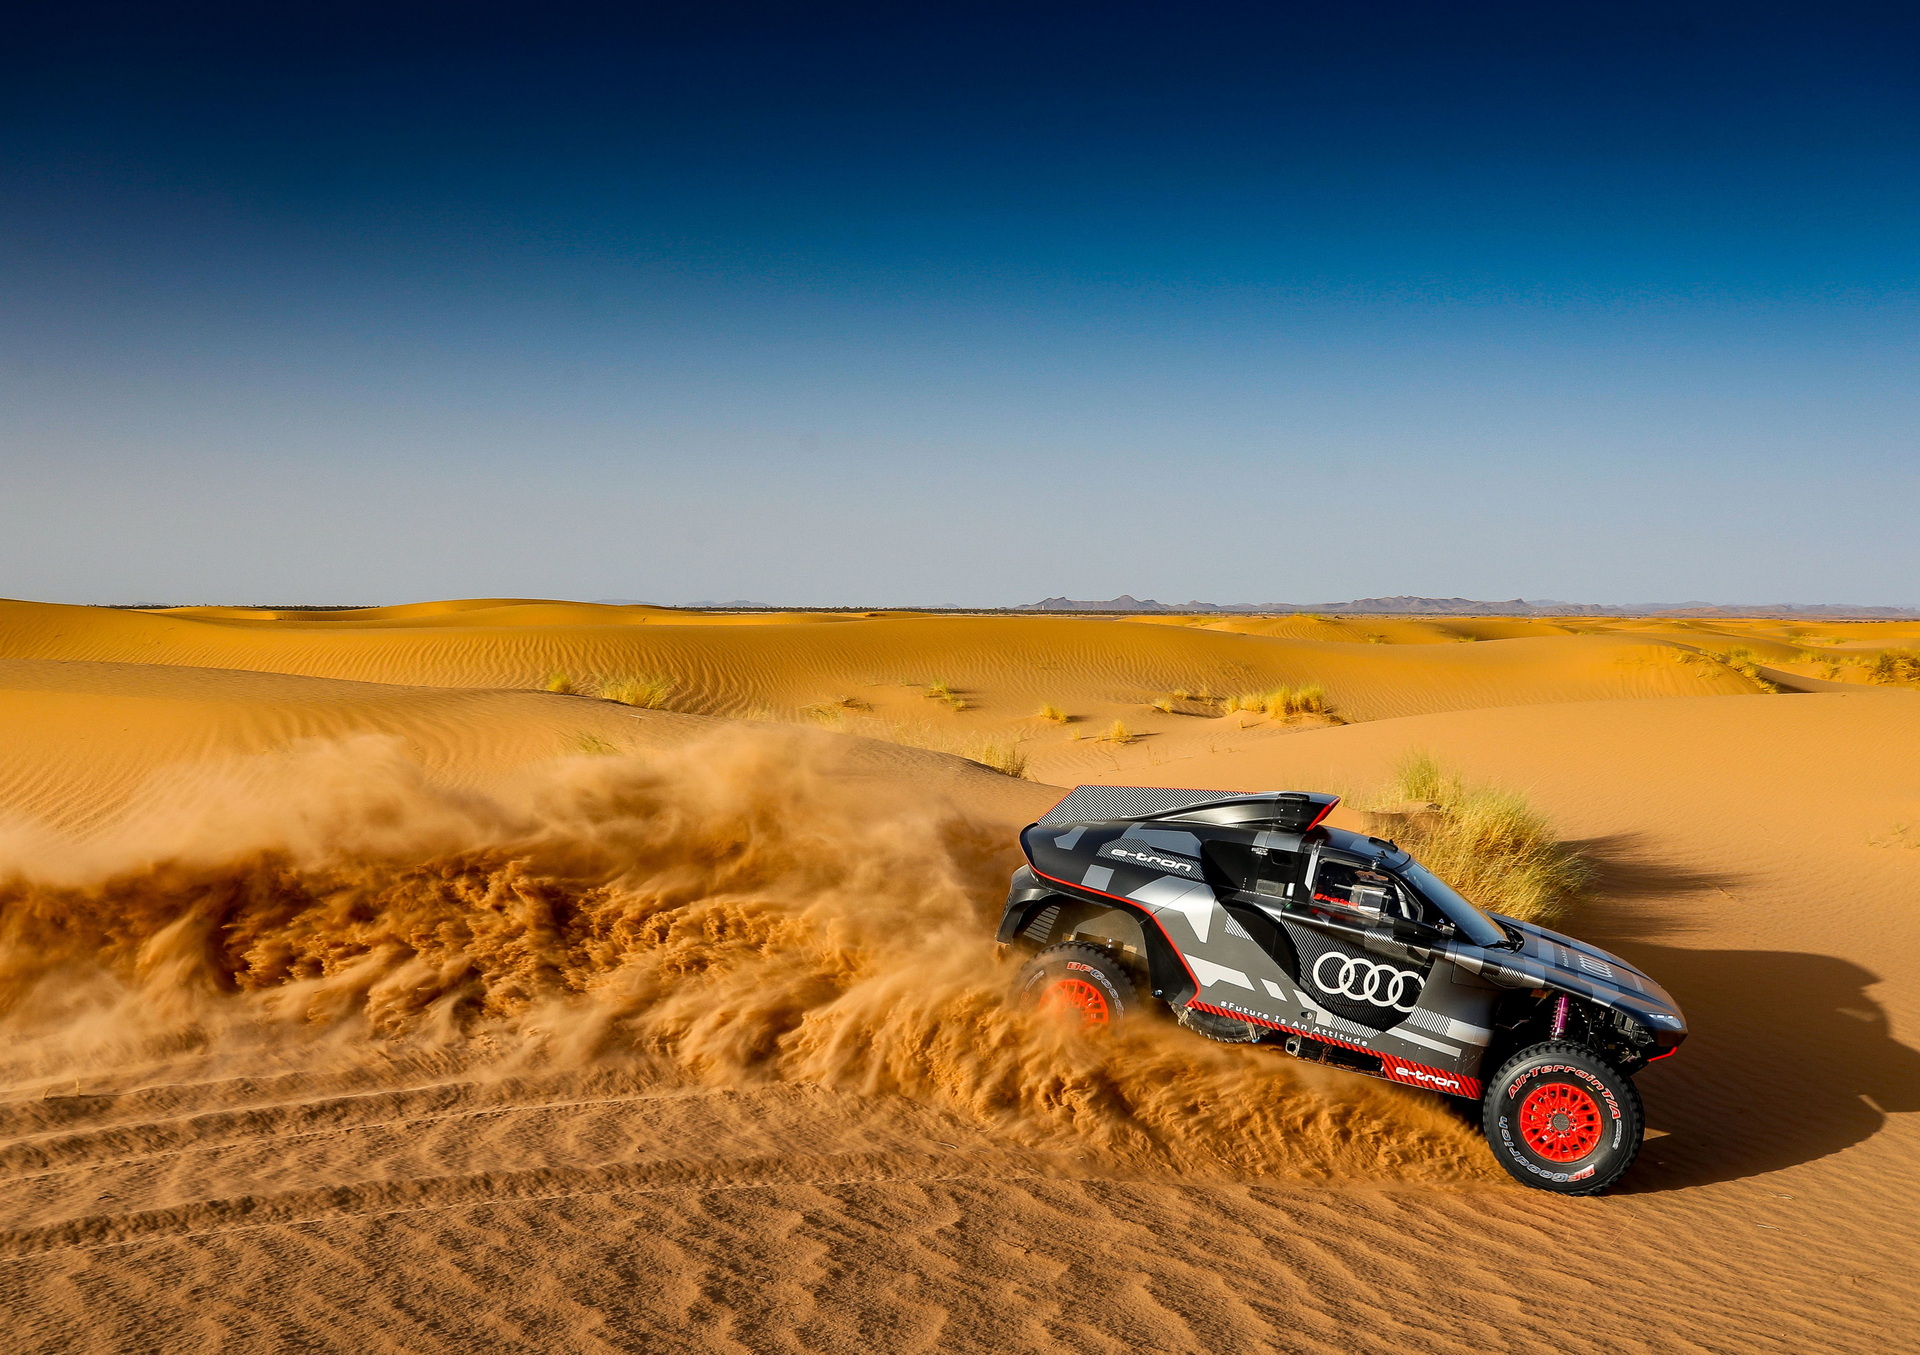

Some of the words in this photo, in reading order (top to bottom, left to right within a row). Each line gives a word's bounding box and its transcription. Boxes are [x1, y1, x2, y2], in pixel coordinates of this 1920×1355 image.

[1111, 848, 1192, 872] e-tron
[1322, 895, 1339, 903] Audi
[1220, 1000, 1270, 1020] #Future
[1274, 1015, 1287, 1025] Is
[1291, 1020, 1308, 1031] An
[1312, 1026, 1368, 1047] Attitude
[1395, 1066, 1459, 1089] e-tron
[1499, 1115, 1596, 1183] BFGoodrich
